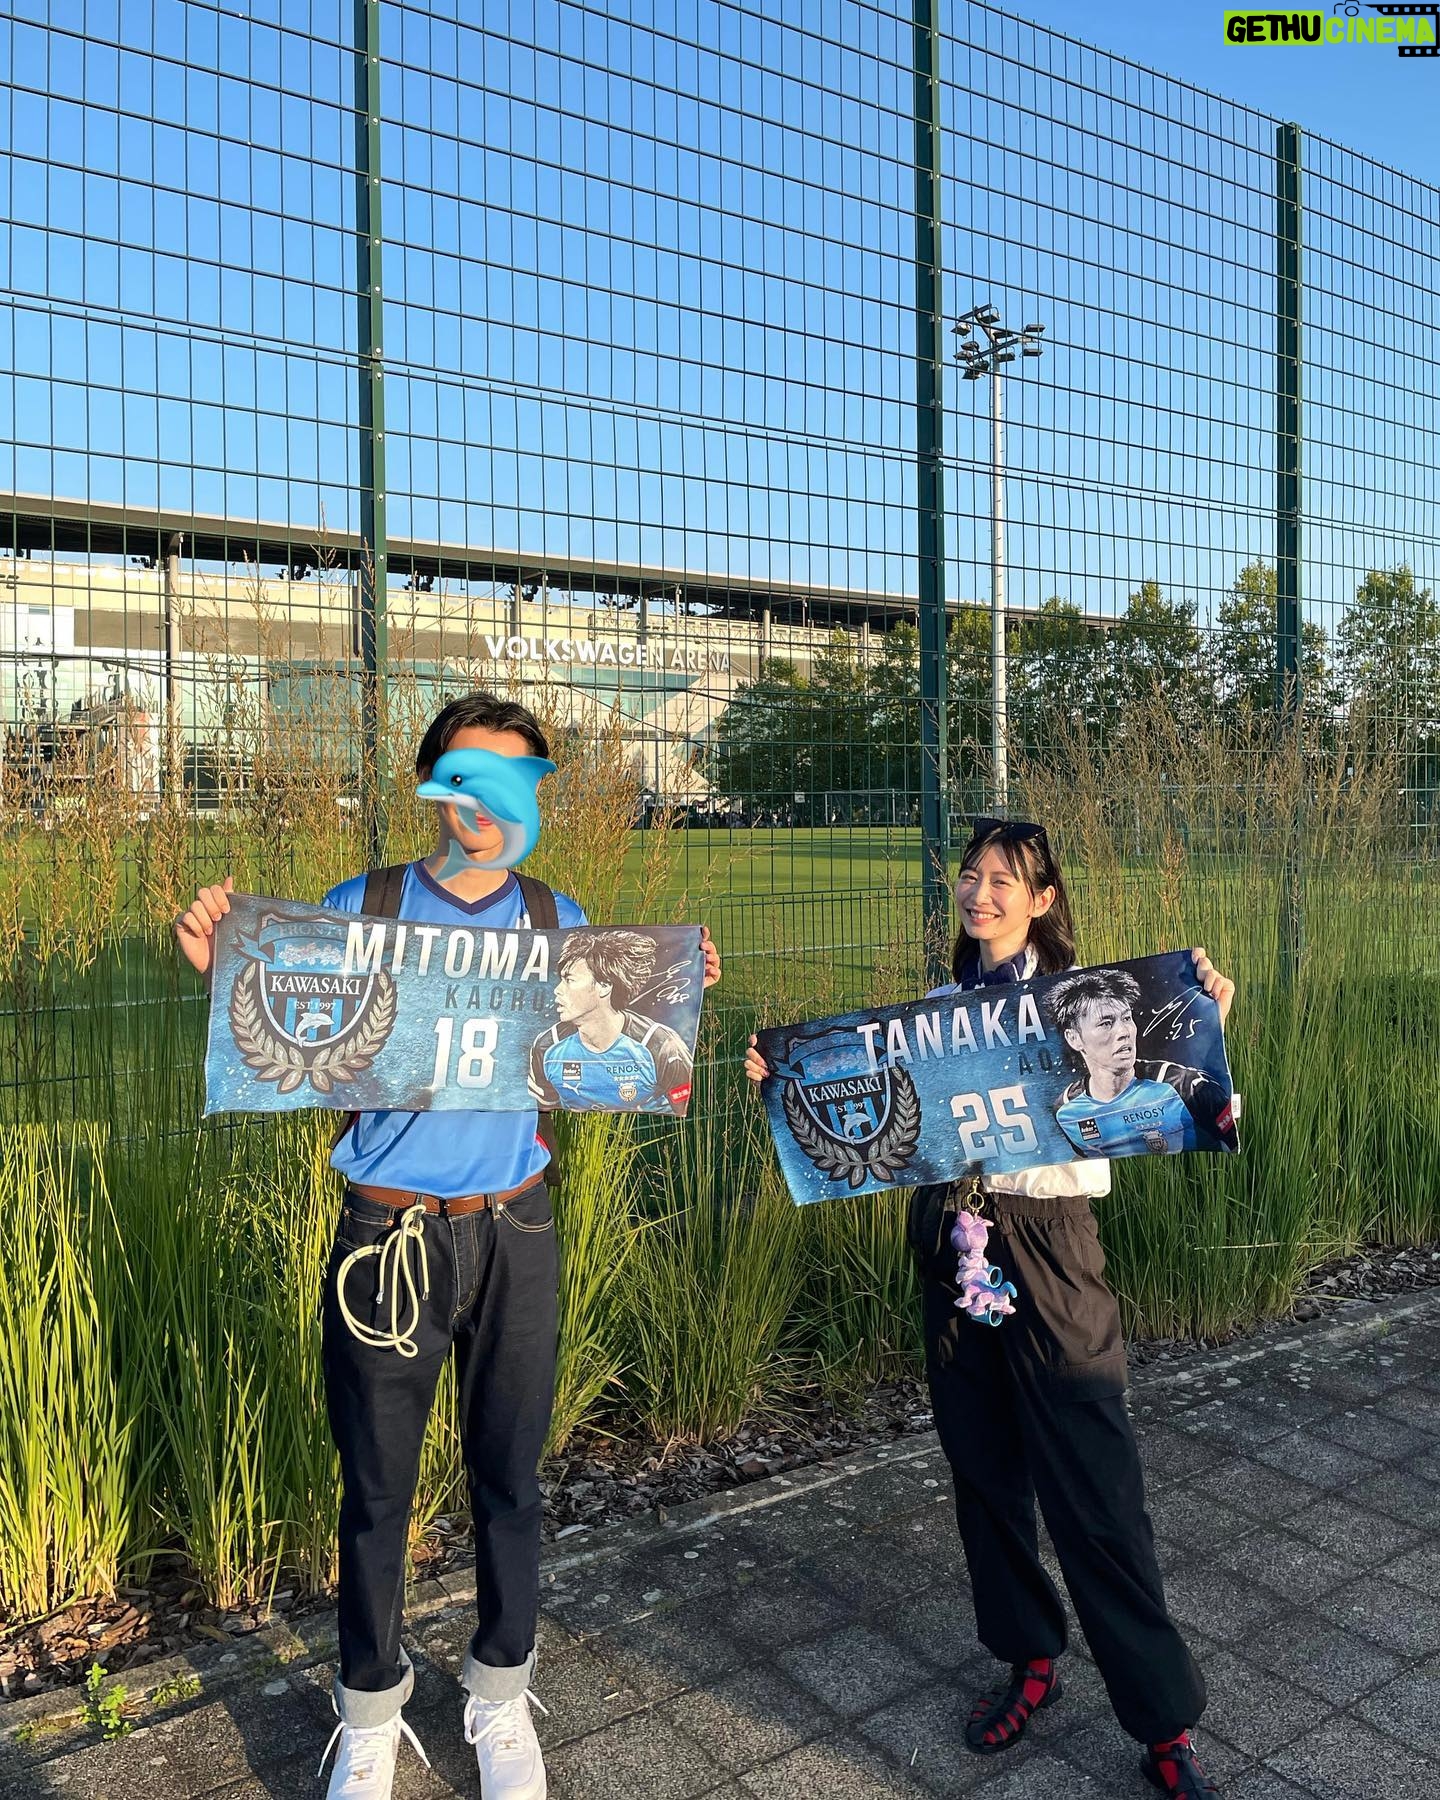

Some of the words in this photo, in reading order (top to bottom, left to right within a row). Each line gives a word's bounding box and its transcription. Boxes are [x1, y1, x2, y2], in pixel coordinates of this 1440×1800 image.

[484, 635, 664, 668] VOLKSWAGEN
[670, 648, 731, 672] ARENA
[344, 921, 550, 983] MITOMA
[270, 975, 362, 996] KAWASAKI
[445, 984, 545, 1012] KAORU
[857, 993, 1047, 1072] TANAKA
[433, 1017, 499, 1089] 18
[1018, 1047, 1053, 1075] AO
[606, 1064, 642, 1074] RENOS
[808, 1076, 882, 1103] KAWASAKI
[950, 1085, 1039, 1161] 25
[1123, 1106, 1166, 1124] RENOSY
